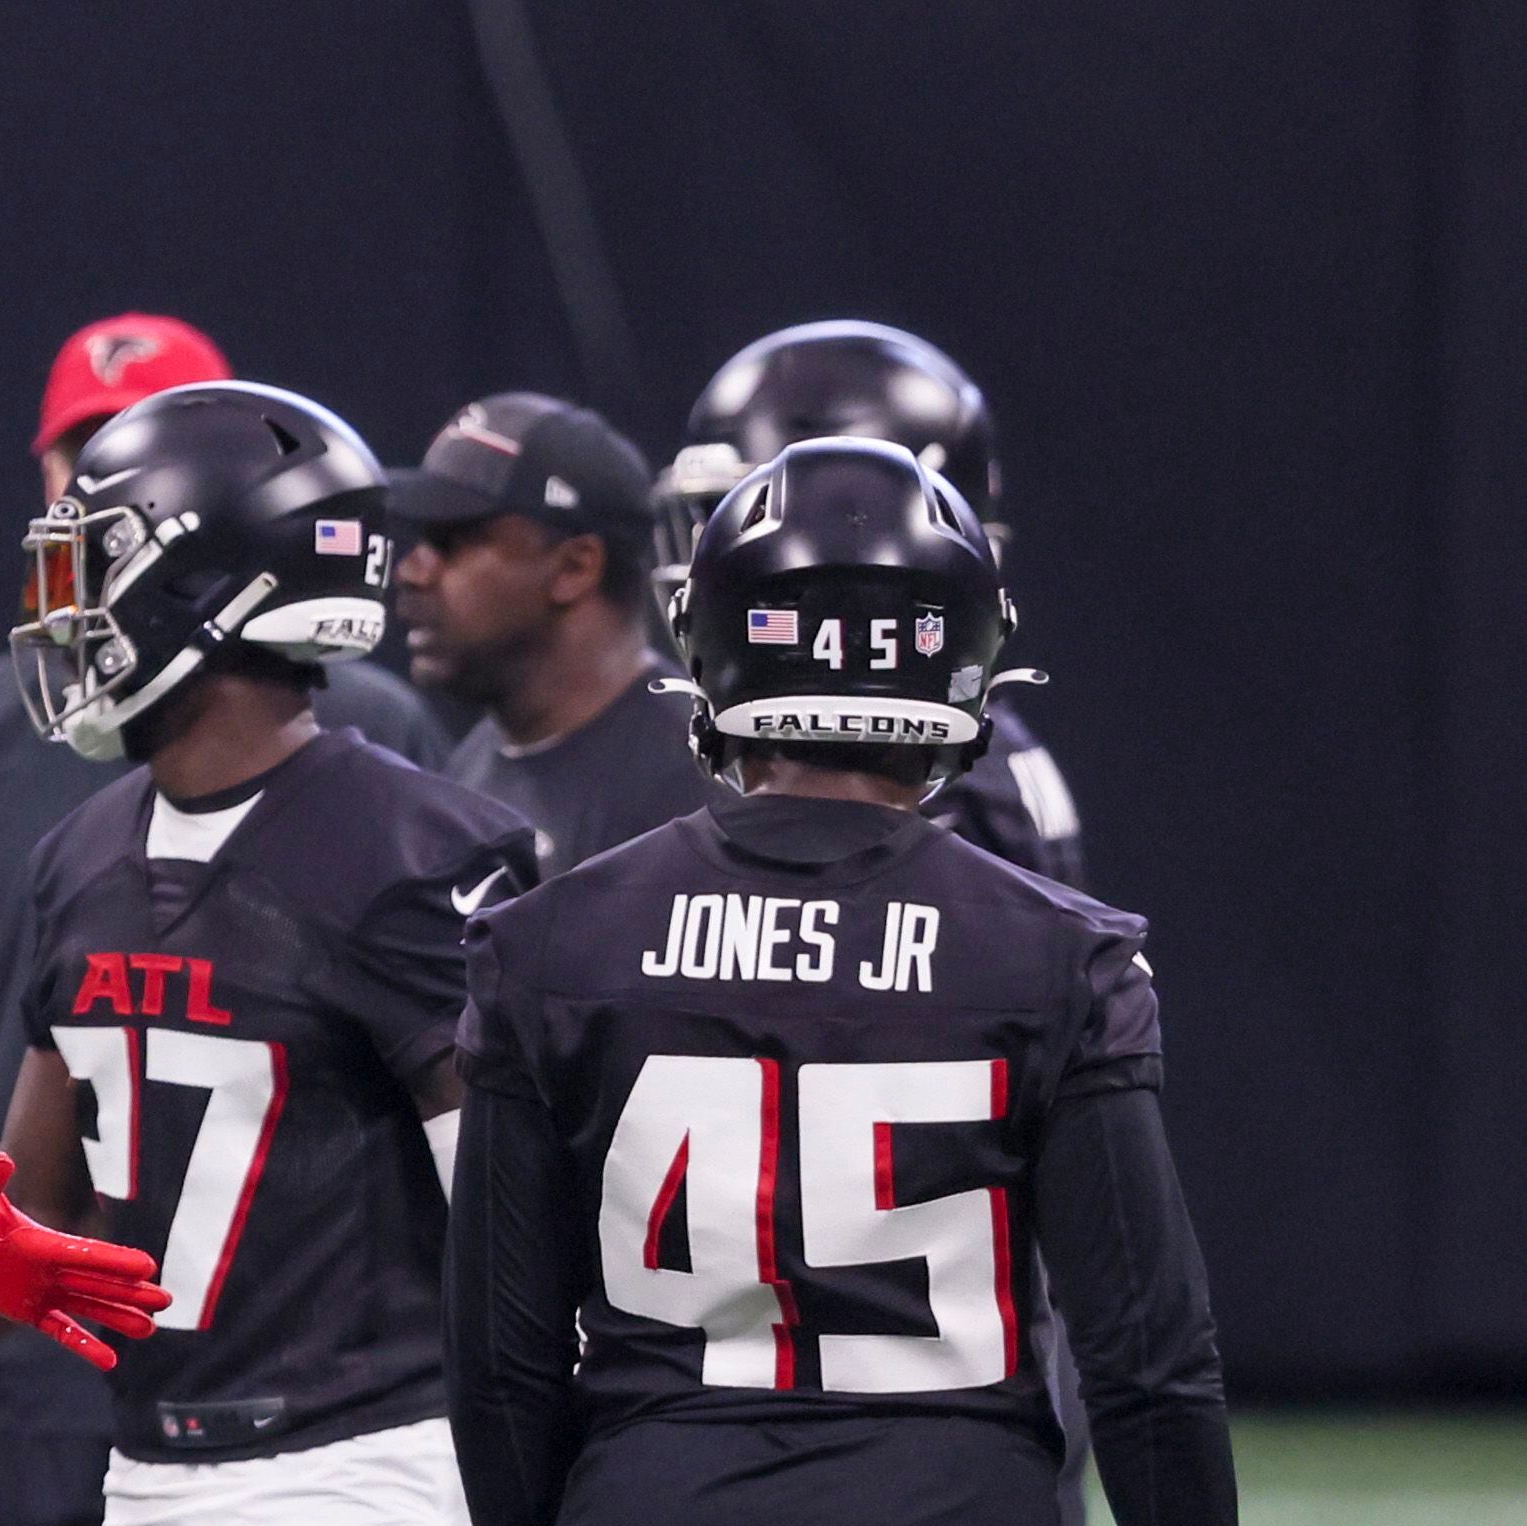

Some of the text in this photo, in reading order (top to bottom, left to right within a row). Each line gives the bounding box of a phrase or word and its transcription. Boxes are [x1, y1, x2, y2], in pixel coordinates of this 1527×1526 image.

[918, 632, 939, 649] NFL
[752, 714, 950, 739] FALCONS
[641, 893, 941, 992] JONES JR
[72, 952, 234, 1026] ATL
[598, 1055, 1020, 1394] 45
